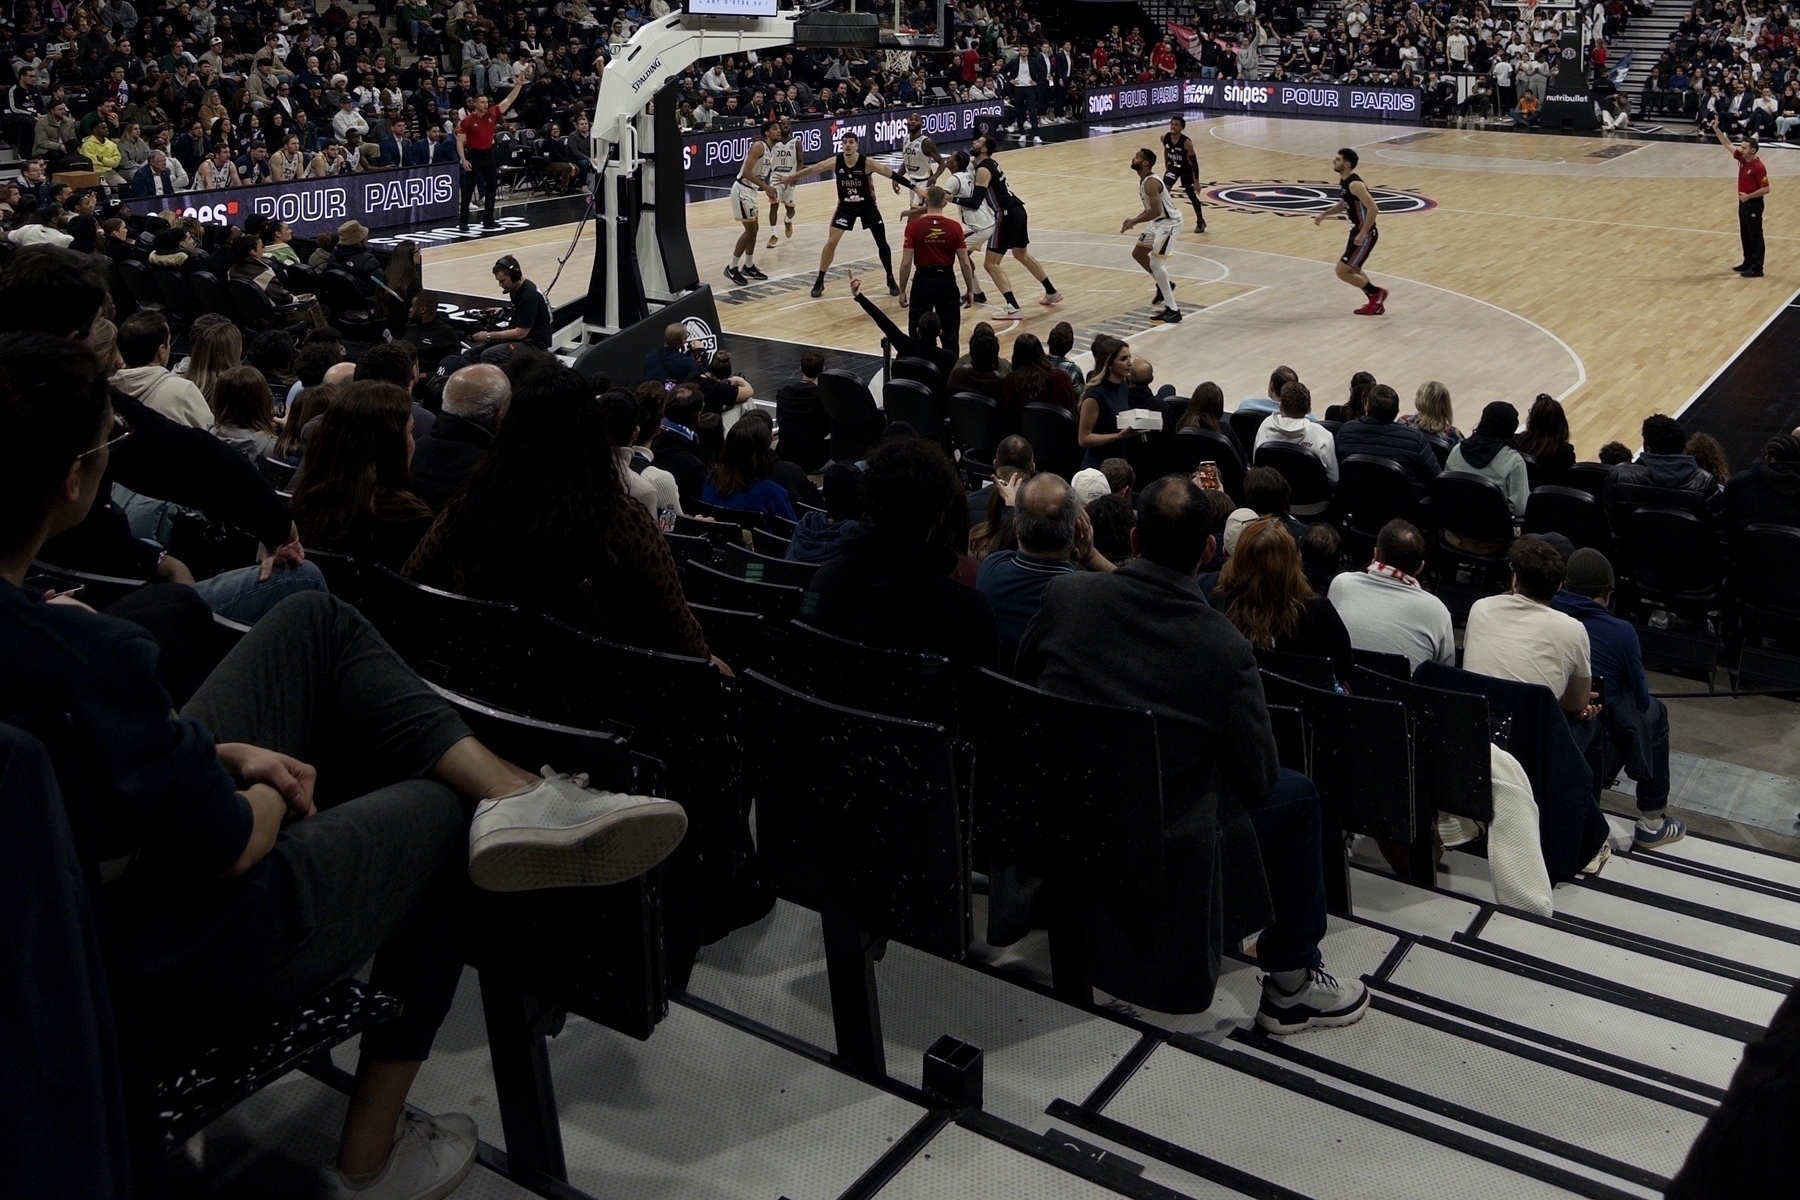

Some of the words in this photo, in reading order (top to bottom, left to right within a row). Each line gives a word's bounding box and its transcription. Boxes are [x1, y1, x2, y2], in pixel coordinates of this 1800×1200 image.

[632, 58, 662, 94] SPALDING
[1089, 94, 1113, 116] snipes
[1118, 89, 1148, 109] POUR
[1151, 85, 1179, 105] PARIS
[1183, 94, 1205, 104] TEAM
[1224, 85, 1268, 106] snipes
[1282, 87, 1339, 107] POUR
[1350, 91, 1415, 111] PARIS
[1546, 93, 1588, 103] nutribullet
[874, 118, 908, 144] snipes
[775, 150, 792, 158] JDA
[364, 174, 453, 213] PARIS
[846, 187, 858, 195] 34
